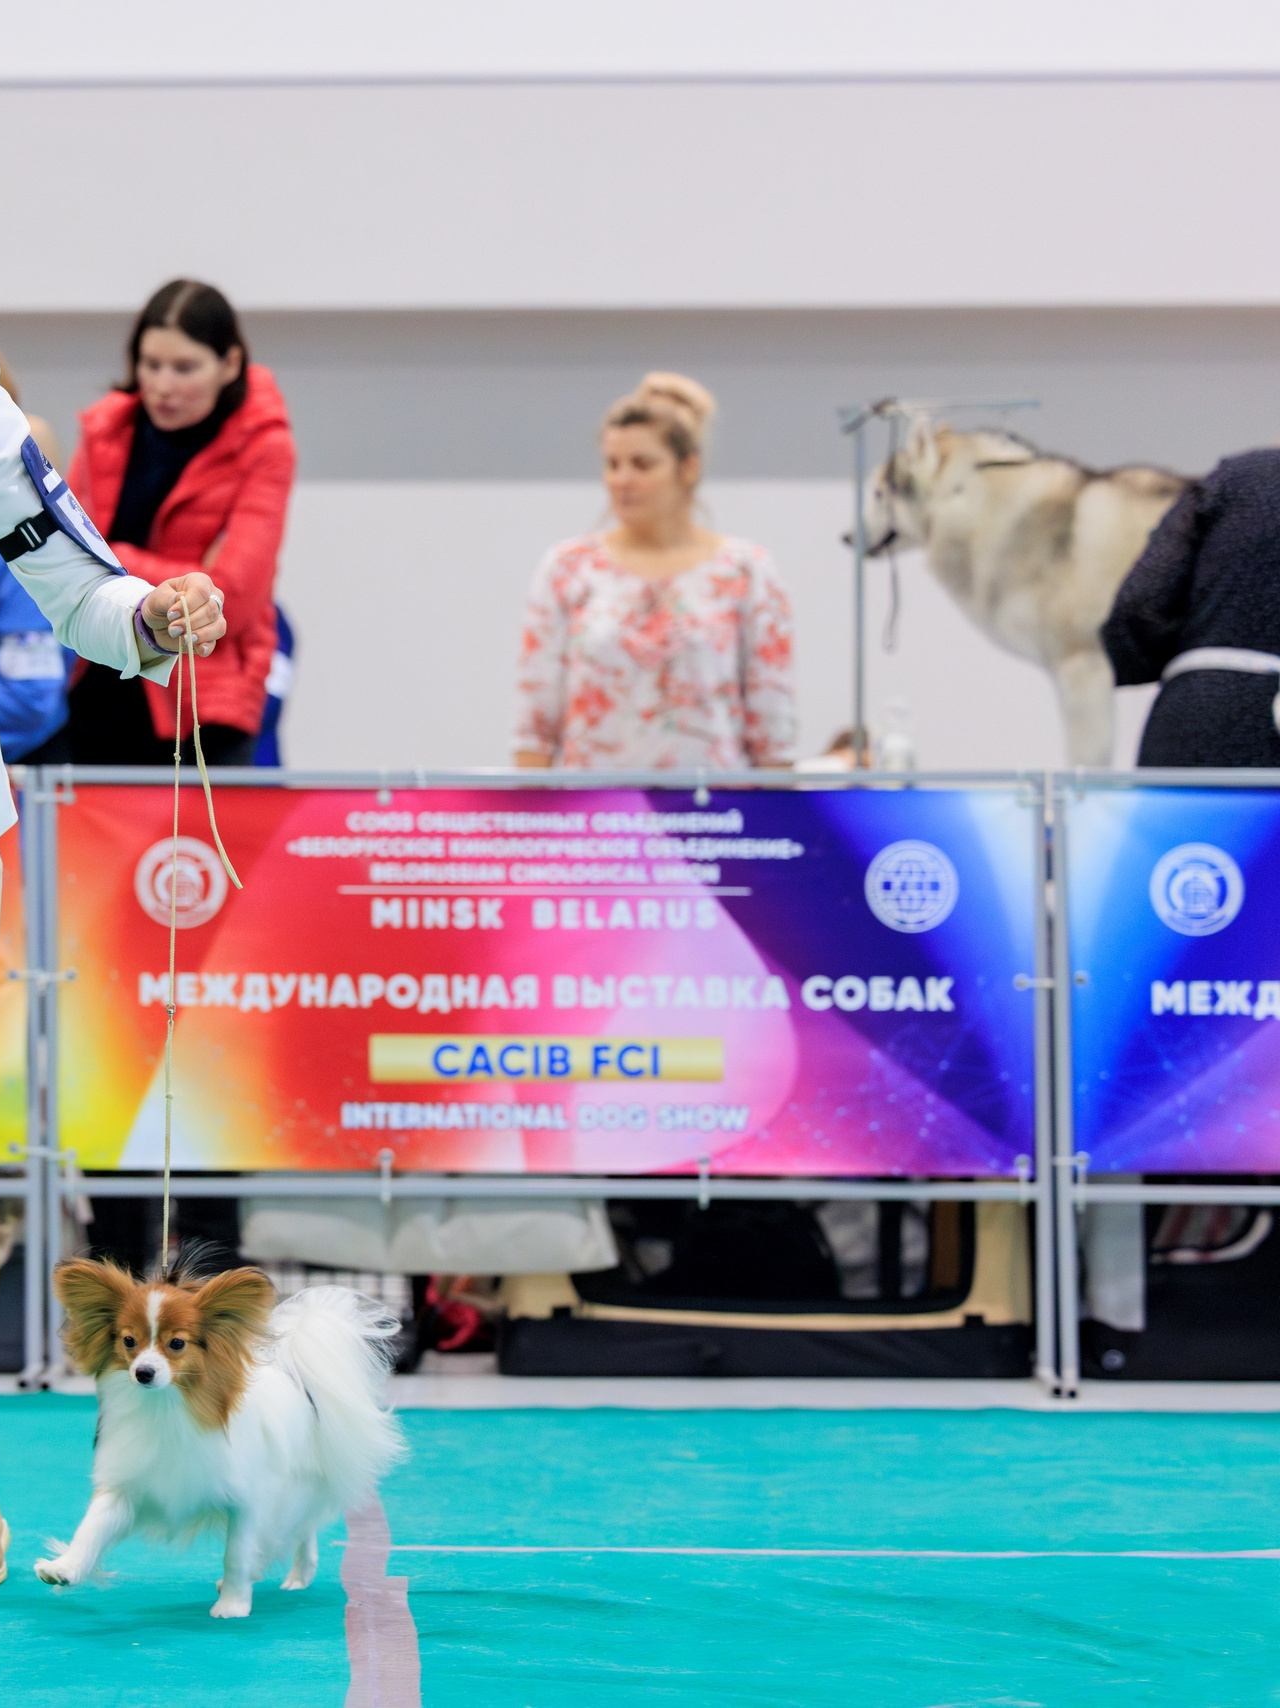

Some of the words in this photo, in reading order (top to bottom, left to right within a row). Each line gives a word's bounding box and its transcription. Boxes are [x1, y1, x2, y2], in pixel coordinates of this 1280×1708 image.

[370, 897, 504, 930] MINSK
[531, 898, 718, 930] BELARUS
[138, 971, 540, 1014] МЕЖДУНАРОДНАЯ
[552, 973, 791, 1010] ВЫСТАВКА
[800, 974, 956, 1013] СОБАК
[432, 1043, 572, 1078] CACIB
[592, 1044, 661, 1078] FCI
[340, 1102, 569, 1130] INTERNATIONAL
[576, 1104, 648, 1131] DOG
[656, 1104, 751, 1131] SHOW
